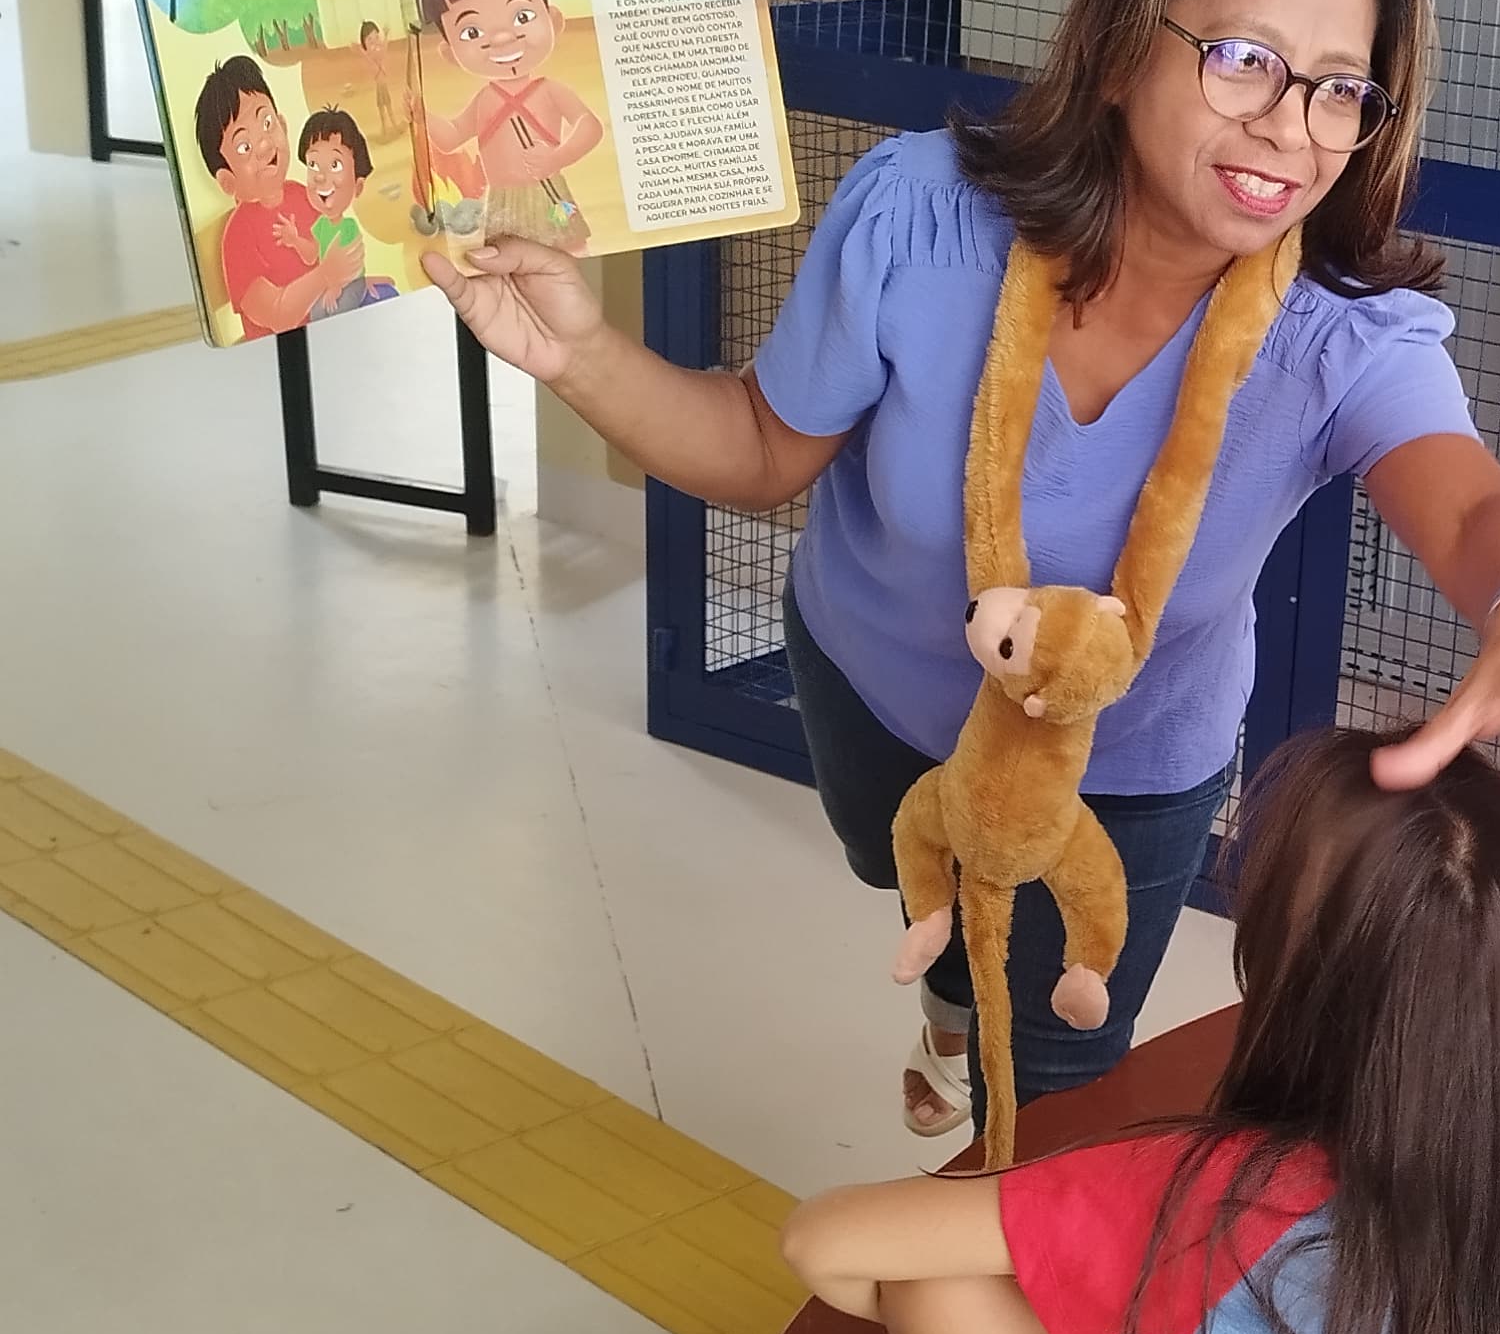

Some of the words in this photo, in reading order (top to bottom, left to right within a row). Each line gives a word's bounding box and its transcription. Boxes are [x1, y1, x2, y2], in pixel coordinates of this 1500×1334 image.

[652, 1, 702, 15] ENQUANTO
[640, 28, 669, 39] OUVIU
[706, 20, 743, 31] CONTAR
[621, 44, 640, 53] QUE
[642, 39, 679, 51] NASCEU
[695, 31, 739, 44] FLORESTA
[687, 47, 707, 57] UMA
[710, 43, 735, 54] TRIBO
[653, 59, 698, 72] CHAMADA
[632, 77, 647, 87] ELE
[701, 66, 740, 78] QUANDO
[676, 82, 702, 92] NOME
[718, 75, 751, 87] MUITOS
[627, 95, 689, 110] PASSARINHOS
[698, 89, 737, 101] PLANTAS
[679, 104, 704, 115] SABIA
[706, 100, 733, 111] COMO
[735, 97, 758, 107] USAR
[653, 119, 678, 130] ARCO
[663, 127, 702, 140] AJUDAVA
[704, 125, 722, 134] SUA
[642, 142, 677, 154] PESCAR
[686, 136, 722, 148] MORAVA
[738, 131, 758, 141] UMA
[636, 156, 660, 166] CASA
[703, 144, 746, 157] CHAMADA
[684, 159, 717, 171] MUITAS
[639, 177, 670, 189] VIVIAM
[686, 170, 718, 182] MESMA
[746, 163, 764, 173] MAS
[637, 190, 662, 200] CADA
[663, 186, 683, 196] UMA
[685, 182, 712, 193] TINHA
[713, 179, 731, 189] SUA
[684, 194, 706, 205] PARA
[708, 187, 753, 201] COZINHAR
[646, 208, 687, 222] AQUECER
[689, 205, 707, 215] NAS
[709, 200, 740, 212] NOITES
